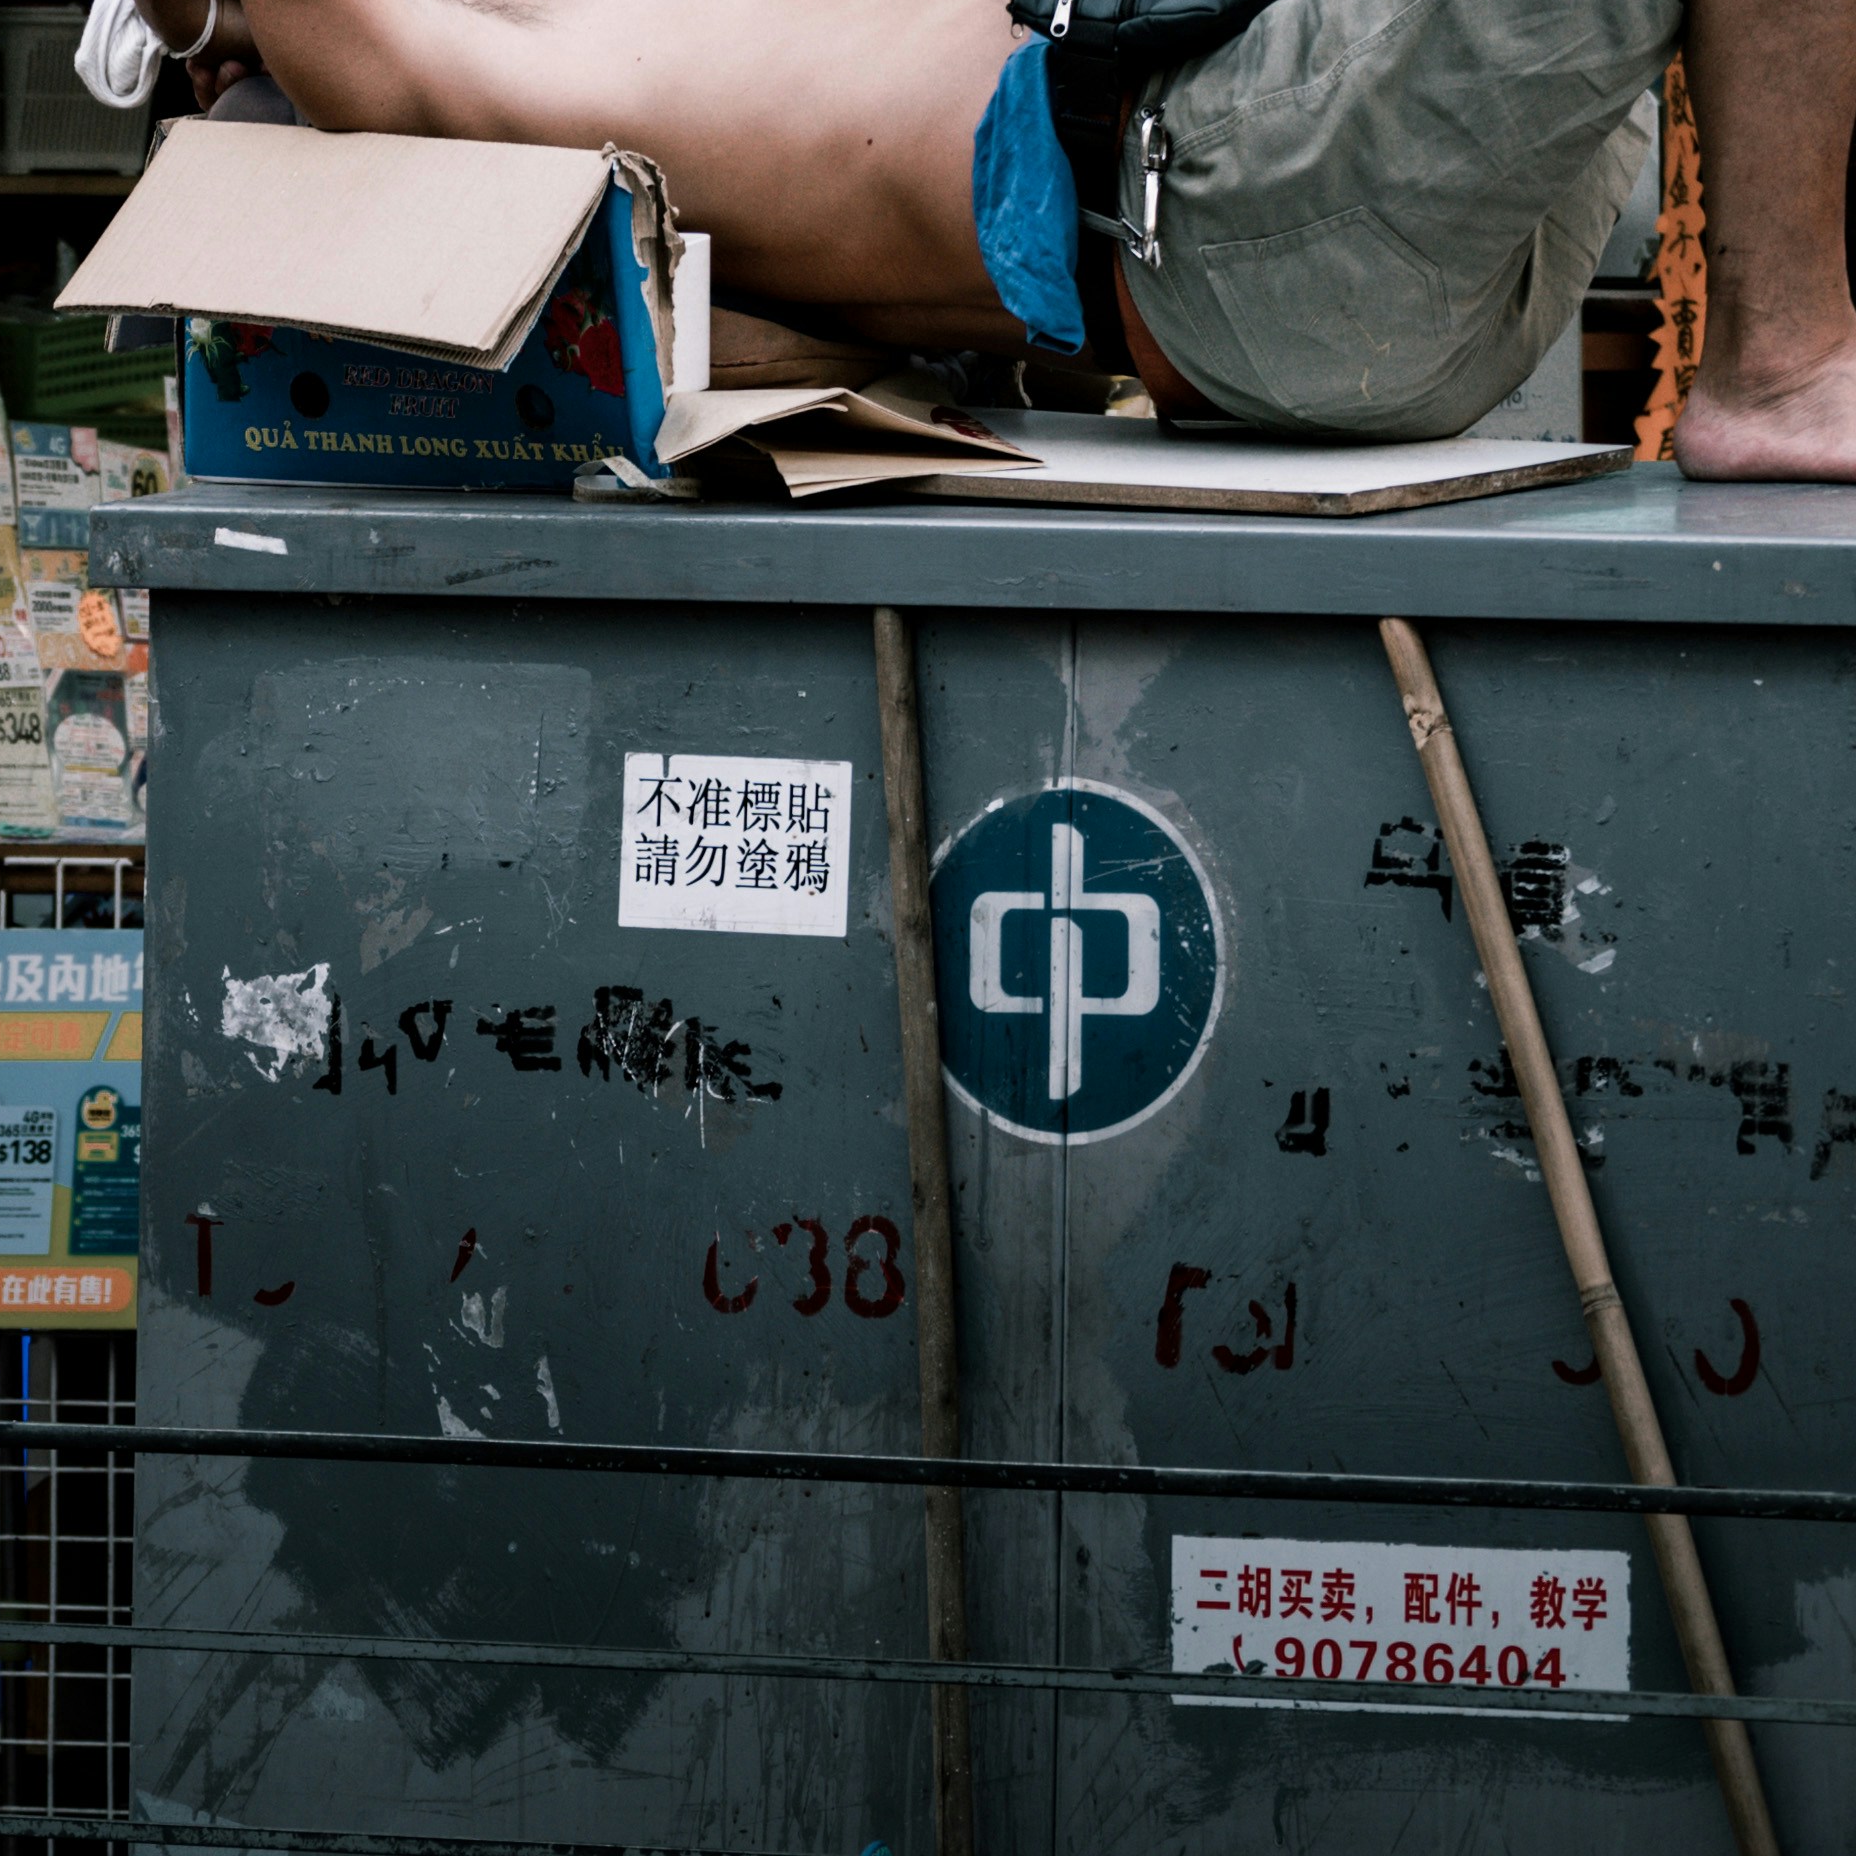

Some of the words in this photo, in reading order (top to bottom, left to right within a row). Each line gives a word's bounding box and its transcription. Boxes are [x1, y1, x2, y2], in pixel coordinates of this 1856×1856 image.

[343, 364, 389, 389] RED
[396, 366, 495, 395] DRAGON
[388, 393, 460, 419] FRUIT
[244, 420, 297, 451] QUẢ
[302, 431, 396, 456] THANH
[399, 434, 470, 459] LONG
[475, 427, 544, 461] XUẤT
[637, 775, 832, 836] 不准標貼
[633, 835, 831, 895] 請勿塗鴉
[1195, 1565, 1611, 1632] 二胡买卖，配件，教学
[1274, 1637, 1568, 1688] 90786404
